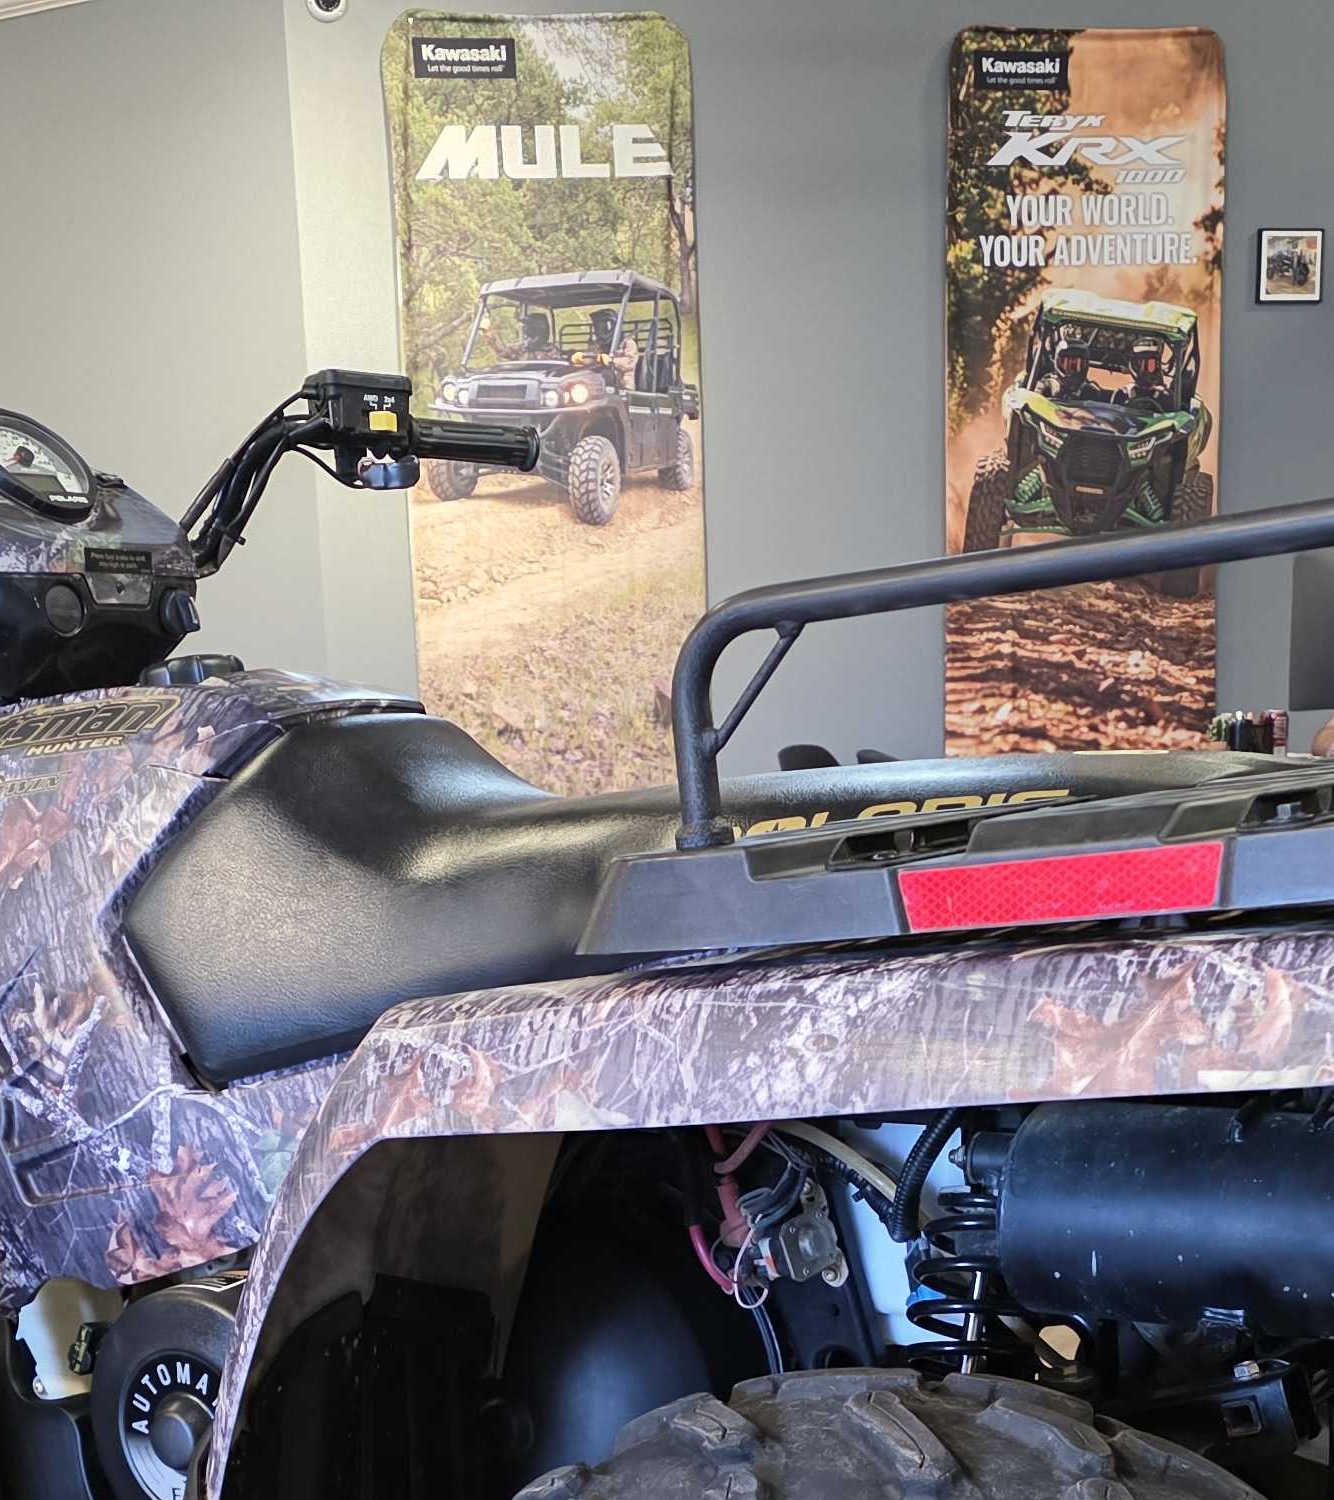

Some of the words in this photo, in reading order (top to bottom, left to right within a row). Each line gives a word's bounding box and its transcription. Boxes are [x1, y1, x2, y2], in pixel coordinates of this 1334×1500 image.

[421, 44, 507, 61] Kawasaki
[428, 64, 439, 73] Let
[439, 64, 452, 73] the
[452, 64, 470, 75] good
[470, 64, 490, 73] times
[982, 57, 1060, 73] Kawasaki
[987, 76, 997, 84] Let
[997, 76, 1008, 84] the
[1009, 77, 1026, 86] good
[416, 124, 675, 180] MULE
[987, 131, 1187, 166] KRX
[1116, 168, 1187, 185] 1000
[1006, 194, 1072, 227] YOUR
[1082, 192, 1174, 226] WORLD.
[979, 234, 1046, 268] YOUR
[1054, 232, 1198, 266] ADVENTURE.
[26, 735, 125, 757] HUNTER
[132, 1362, 218, 1434] AUTOMA
